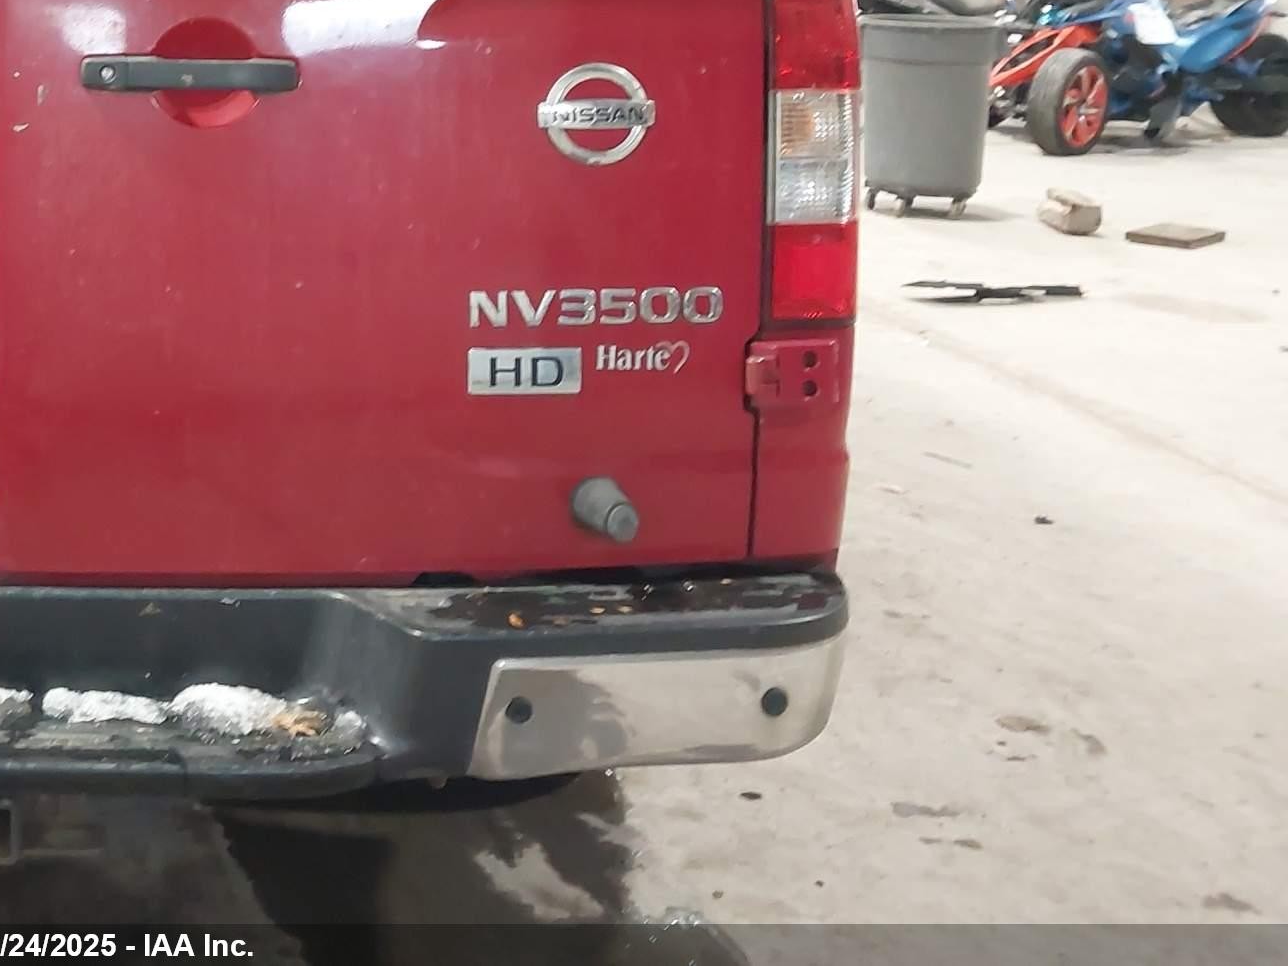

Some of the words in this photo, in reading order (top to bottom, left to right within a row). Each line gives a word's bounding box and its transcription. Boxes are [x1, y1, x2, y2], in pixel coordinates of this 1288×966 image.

[551, 106, 644, 124] NISSAN
[469, 287, 723, 328] NV3500
[596, 344, 671, 371] Harte
[489, 357, 564, 388] HD
